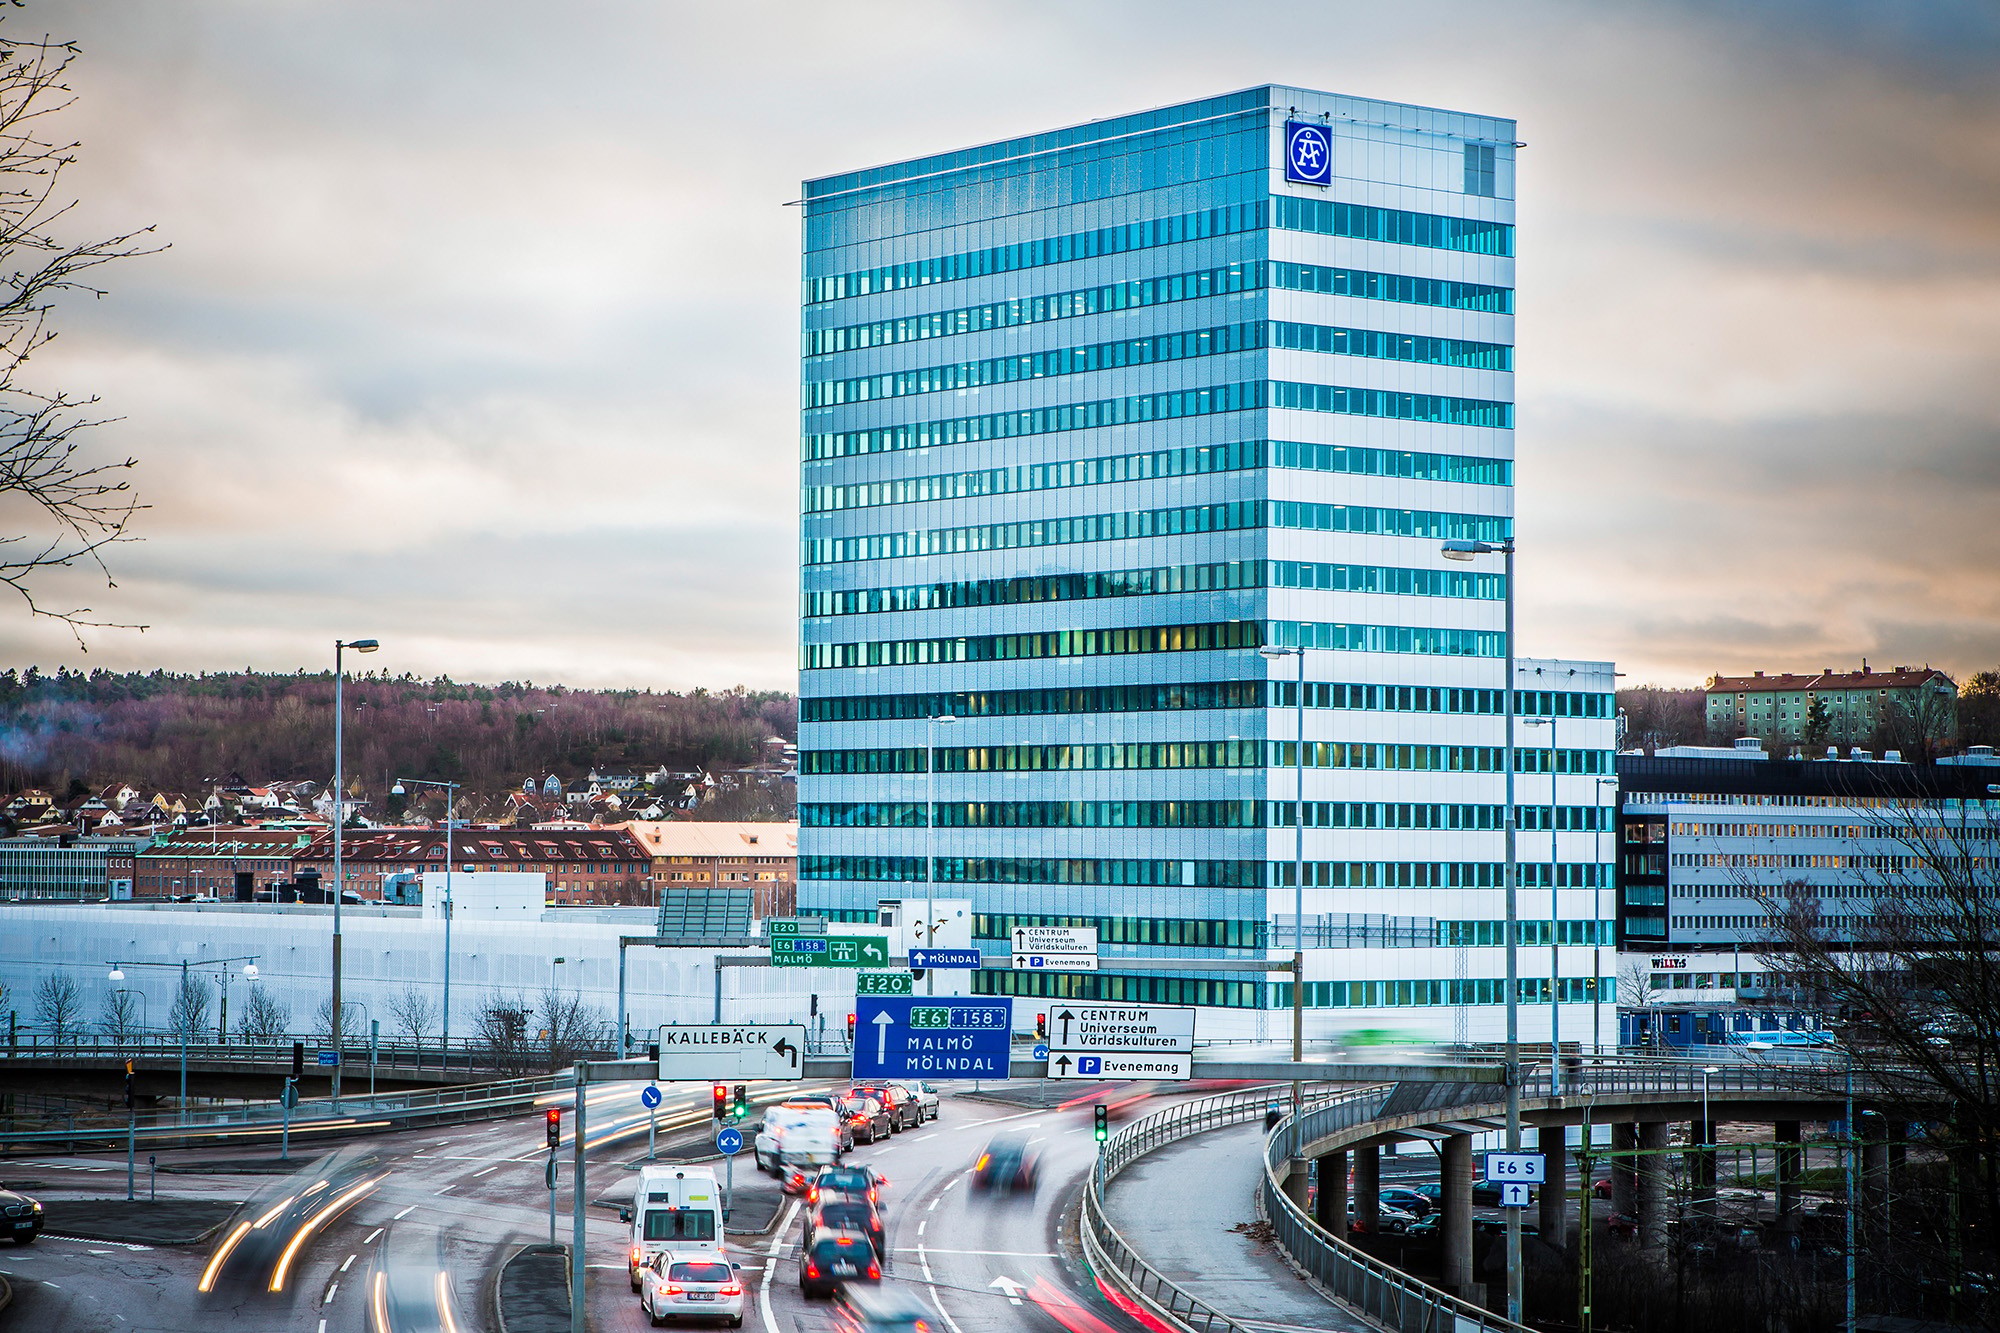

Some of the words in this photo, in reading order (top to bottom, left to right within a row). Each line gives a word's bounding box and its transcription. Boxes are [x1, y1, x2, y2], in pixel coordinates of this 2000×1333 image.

[774, 924, 795, 932] E20
[777, 941, 791, 950] E6
[801, 941, 819, 950] 158
[1028, 943, 1088, 951] Världskulturen
[774, 953, 813, 964] MALMÖ
[929, 953, 978, 963] MÖLNDAL
[1034, 958, 1040, 966] P
[1045, 959, 1091, 967] Evenemang
[867, 978, 903, 990] E20
[919, 1012, 941, 1024] E6
[963, 1012, 993, 1024] 158
[1080, 1010, 1149, 1022] CENTRUM
[1080, 1022, 1157, 1034] Universeum
[667, 1028, 768, 1045] KALLEBÄCK
[907, 1035, 974, 1050] MALMÖ
[1080, 1034, 1177, 1047] Världskulturen
[907, 1055, 994, 1070] MÖLNDAL
[1085, 1059, 1095, 1072] P
[1104, 1060, 1179, 1074] Evenemang
[1497, 1161, 1517, 1174] E6
[1525, 1162, 1535, 1175] S
